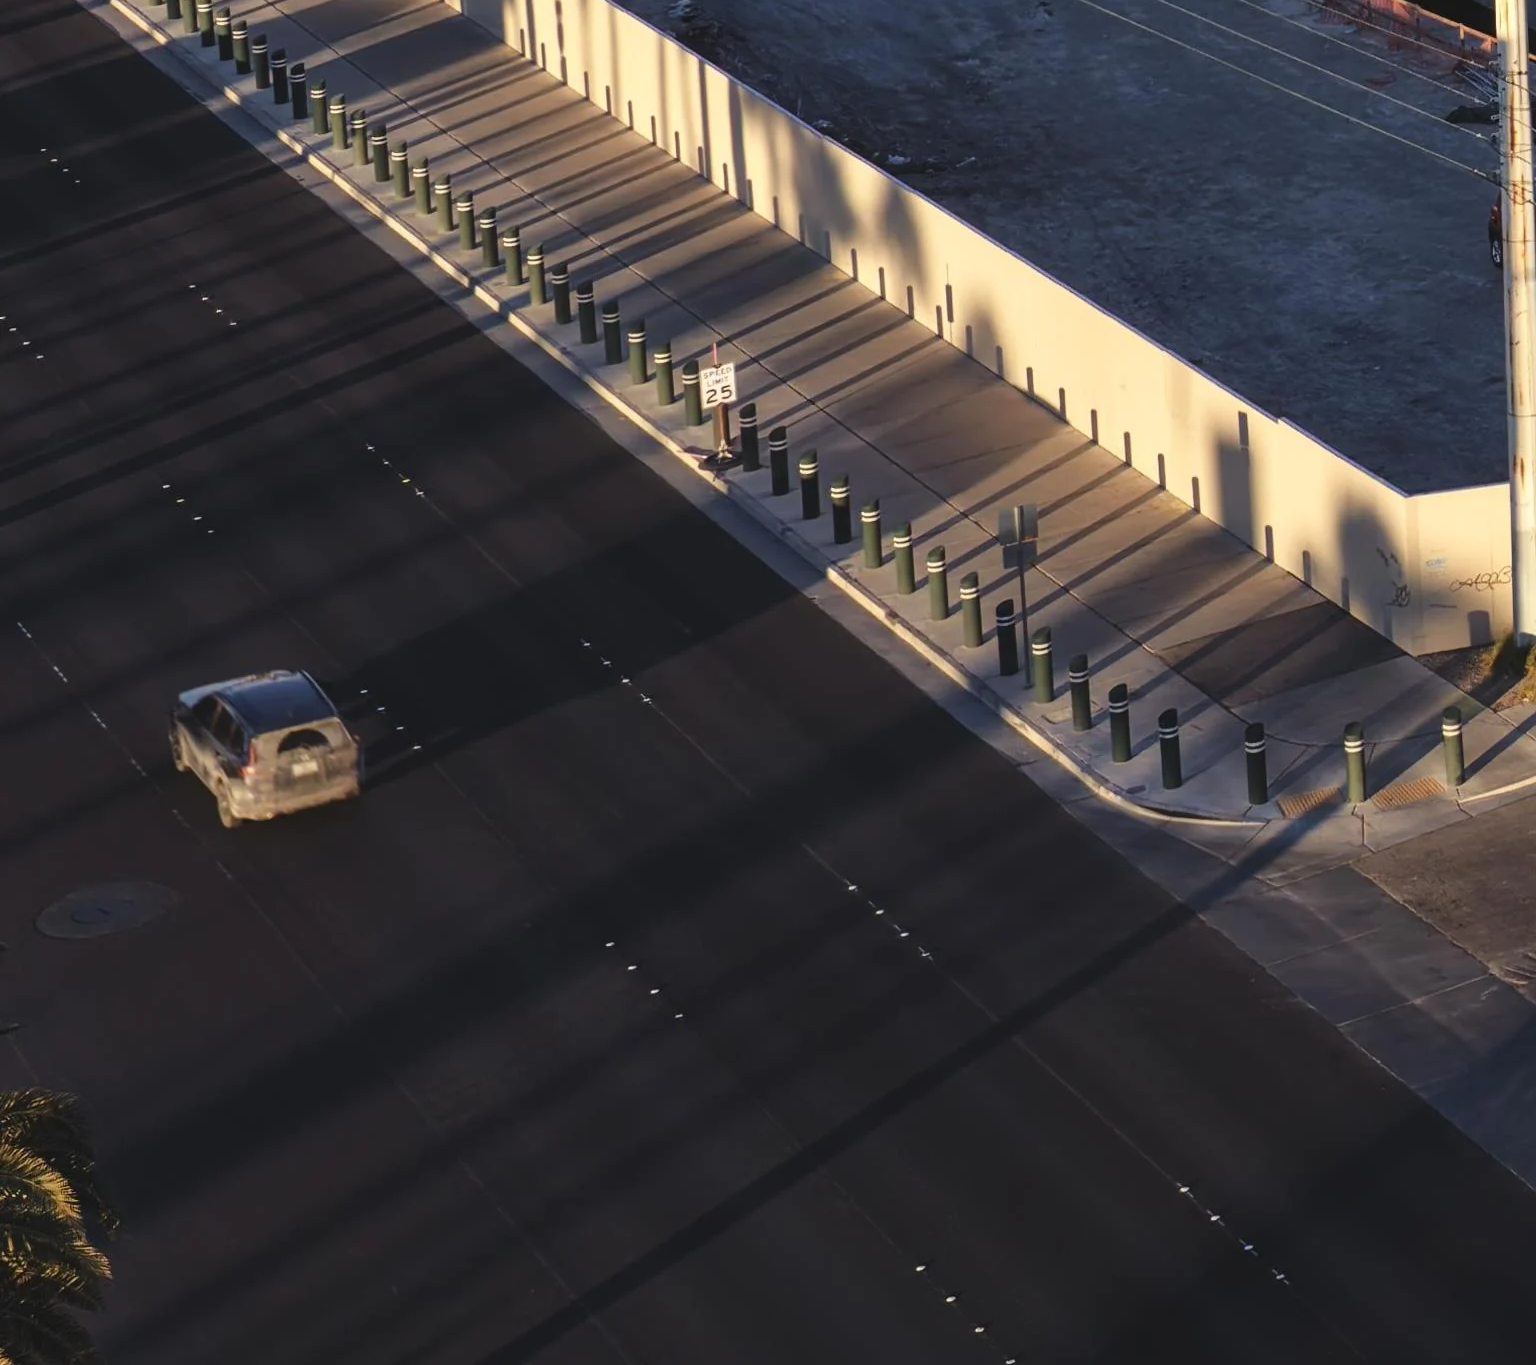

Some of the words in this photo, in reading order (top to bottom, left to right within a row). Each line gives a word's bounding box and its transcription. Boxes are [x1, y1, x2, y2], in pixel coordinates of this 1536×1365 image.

[703, 367, 732, 380] SPEED
[707, 376, 728, 387] LIMIT
[706, 385, 732, 404] 25
